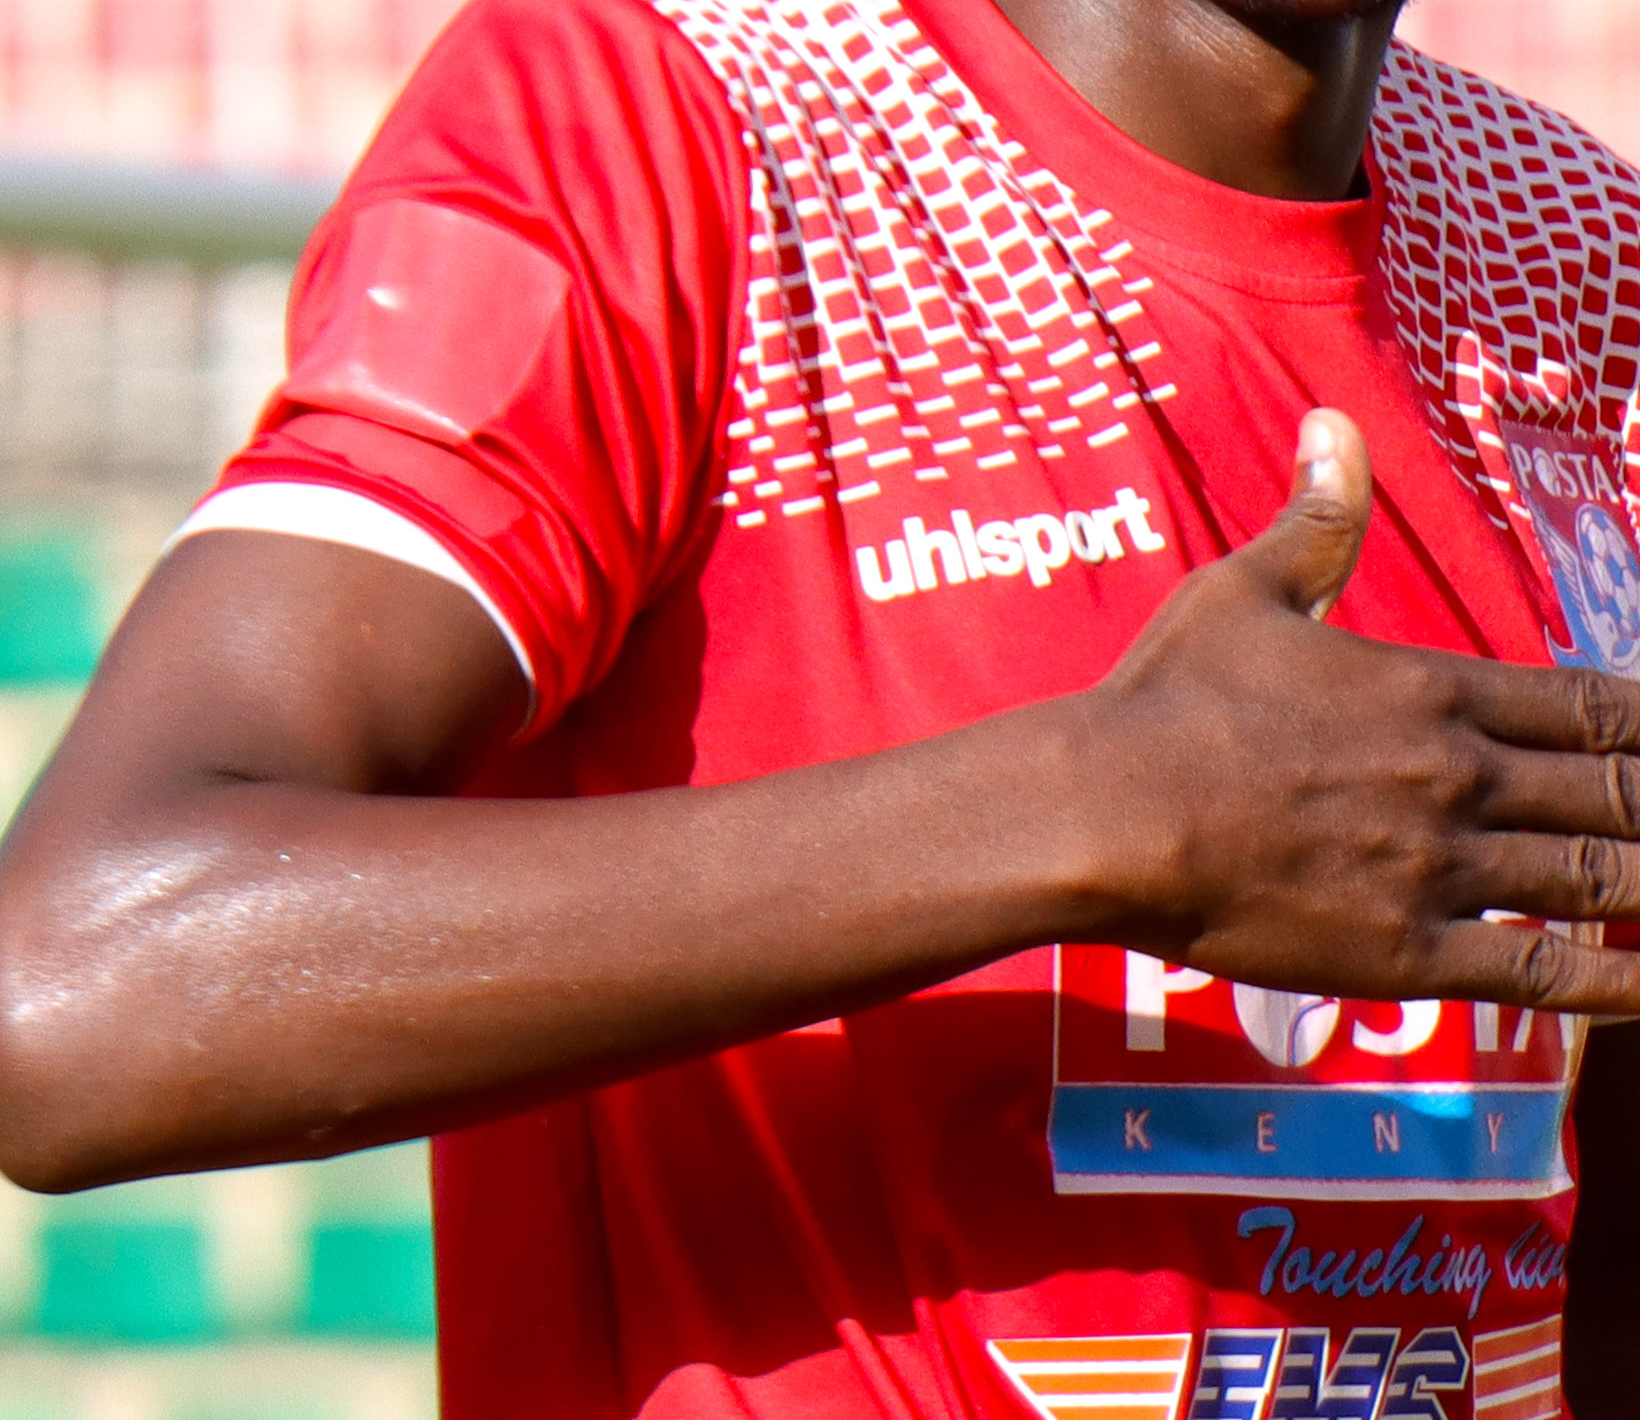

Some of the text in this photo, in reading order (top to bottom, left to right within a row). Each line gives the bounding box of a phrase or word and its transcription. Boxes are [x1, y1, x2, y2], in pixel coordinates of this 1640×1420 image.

[1511, 442, 1621, 505] POSTA
[856, 487, 1166, 601] uhlsport
[1123, 1108, 1506, 1155] KENY
[1237, 1205, 1492, 1320] Touching
